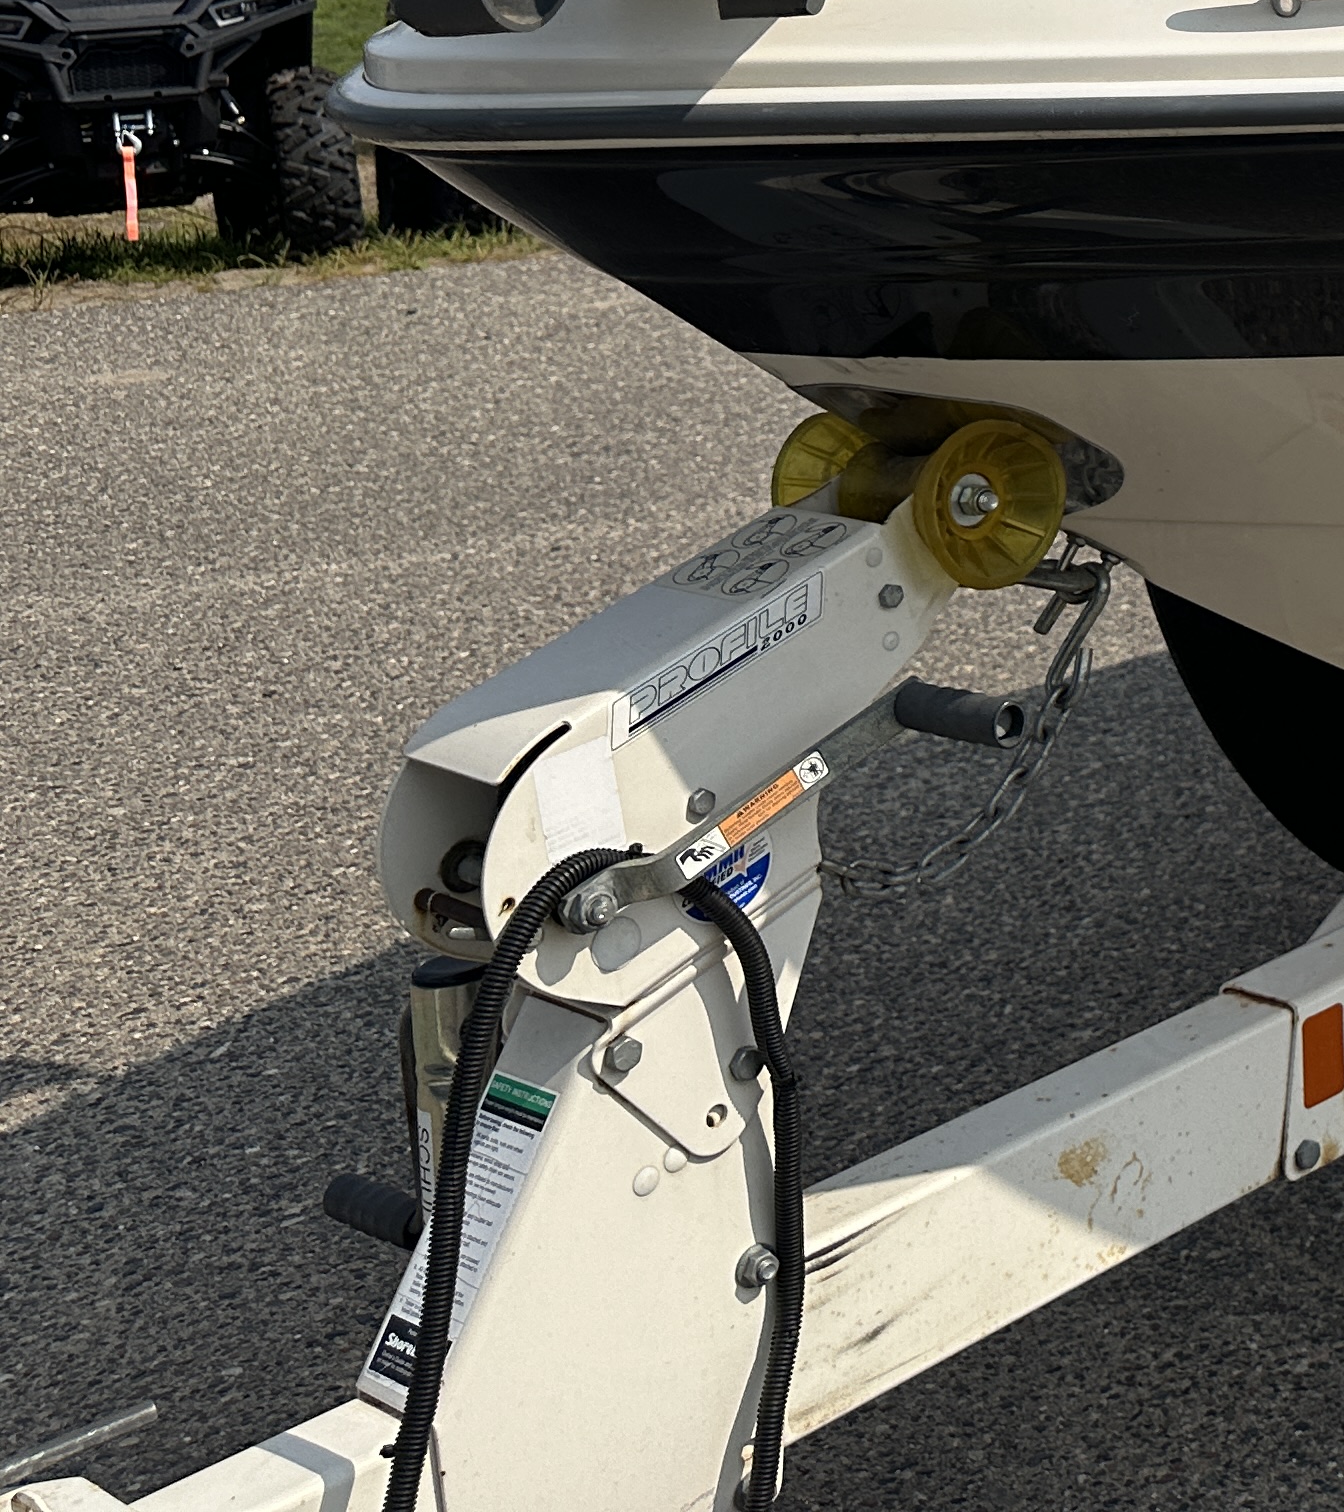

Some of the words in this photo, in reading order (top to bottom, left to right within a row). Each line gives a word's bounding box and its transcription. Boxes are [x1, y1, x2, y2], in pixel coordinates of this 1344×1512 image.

[759, 612, 808, 652] 2000
[628, 583, 809, 726] PROFILE
[742, 782, 779, 813] WARNING
